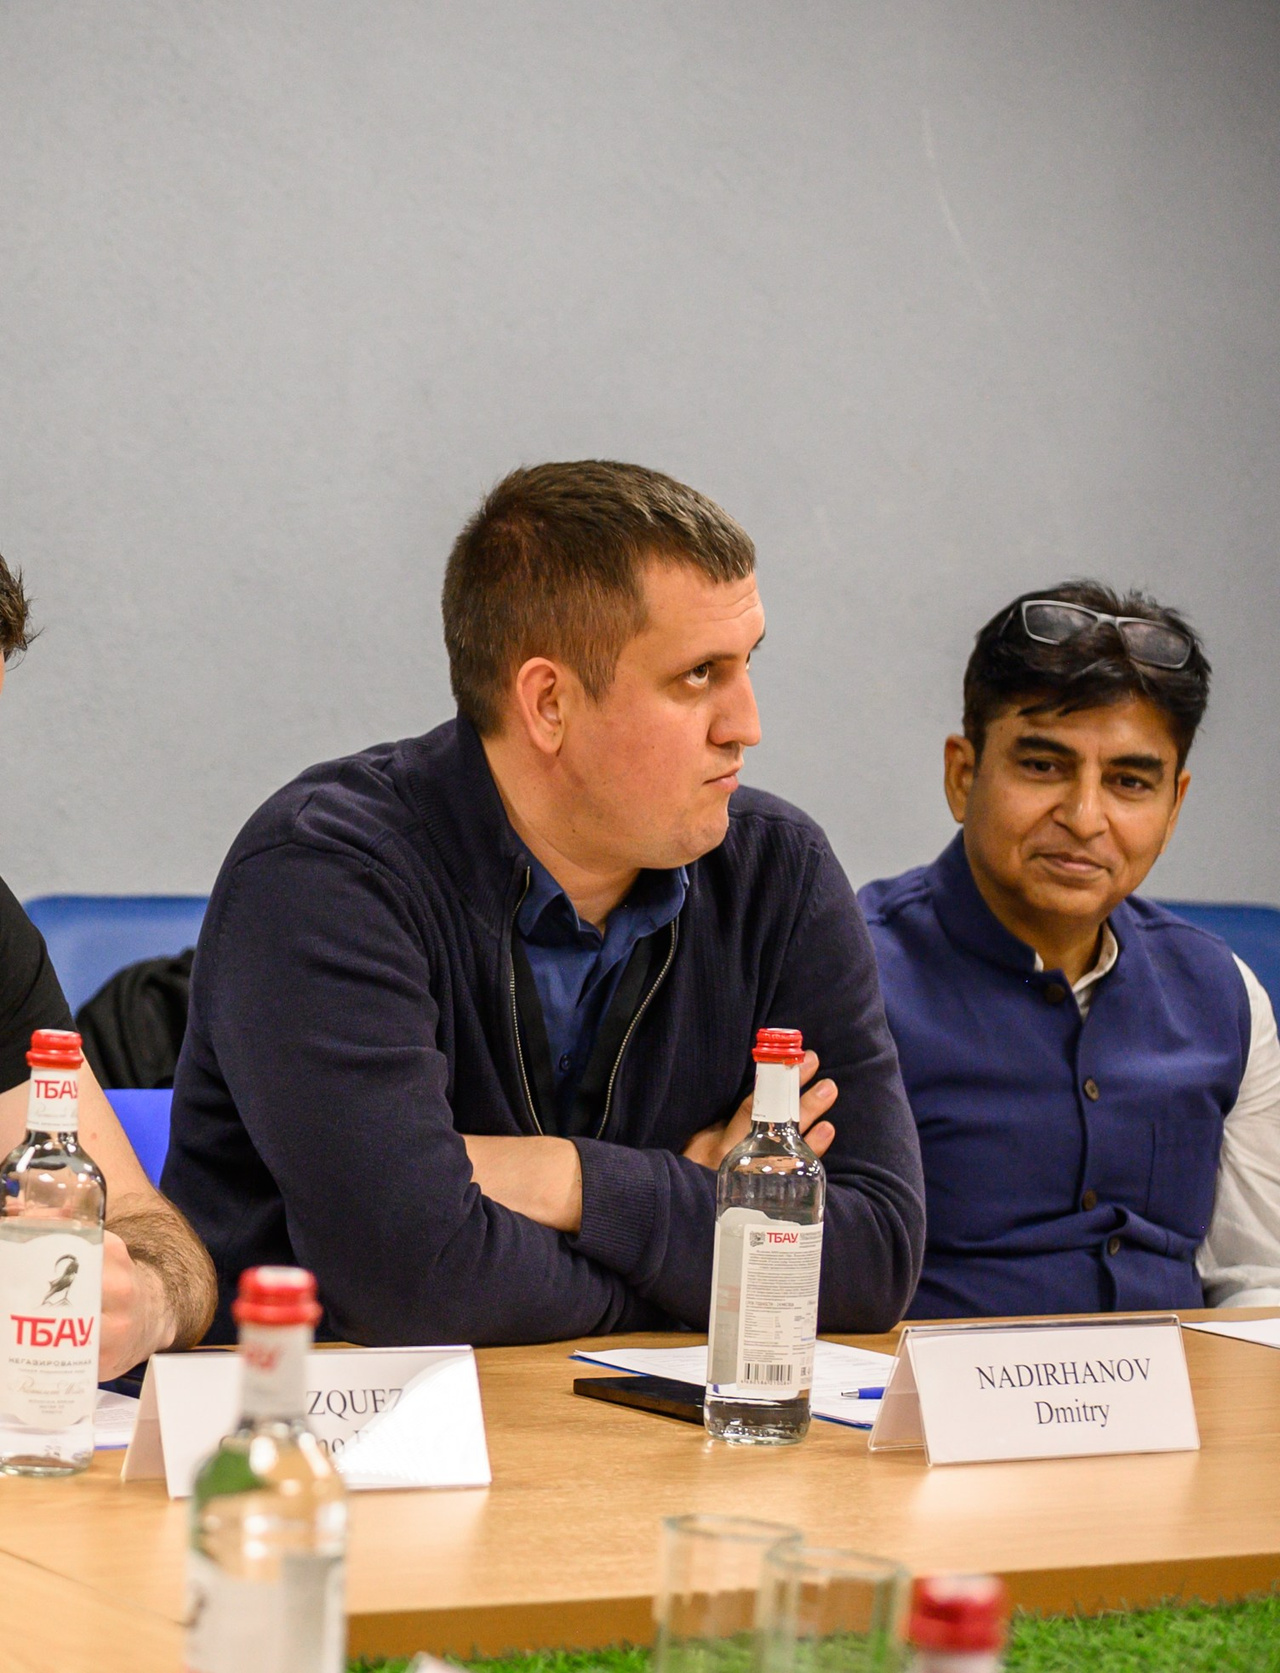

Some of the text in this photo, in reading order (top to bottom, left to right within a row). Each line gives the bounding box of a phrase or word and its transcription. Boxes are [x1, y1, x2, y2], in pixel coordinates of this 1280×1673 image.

[766, 1231, 799, 1244] ТБАУ
[10, 1314, 94, 1348] ТБАУ
[974, 1357, 1151, 1390] NADIRHANOV
[305, 1387, 404, 1421] ZQUEZ
[1033, 1398, 1111, 1428] Dmitry
